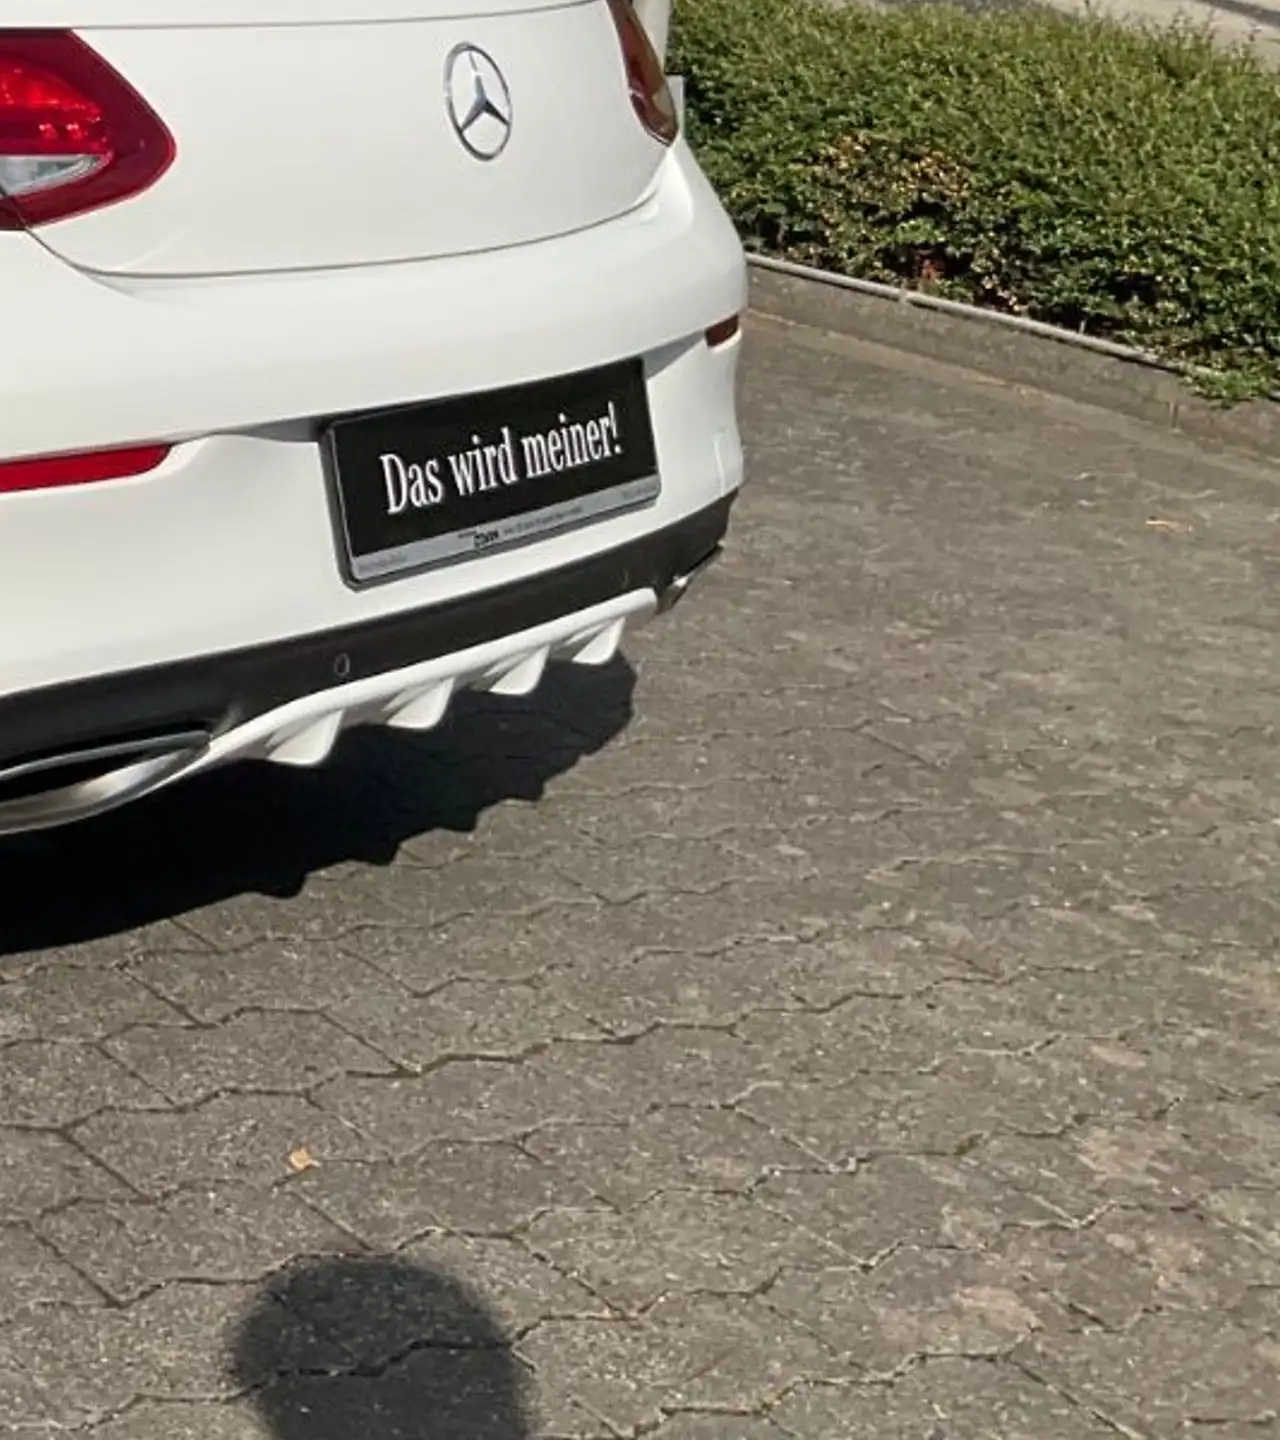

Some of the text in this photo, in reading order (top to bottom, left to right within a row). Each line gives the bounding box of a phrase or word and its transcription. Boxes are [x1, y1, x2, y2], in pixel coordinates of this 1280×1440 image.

[379, 400, 622, 515] Das wird meiner!
